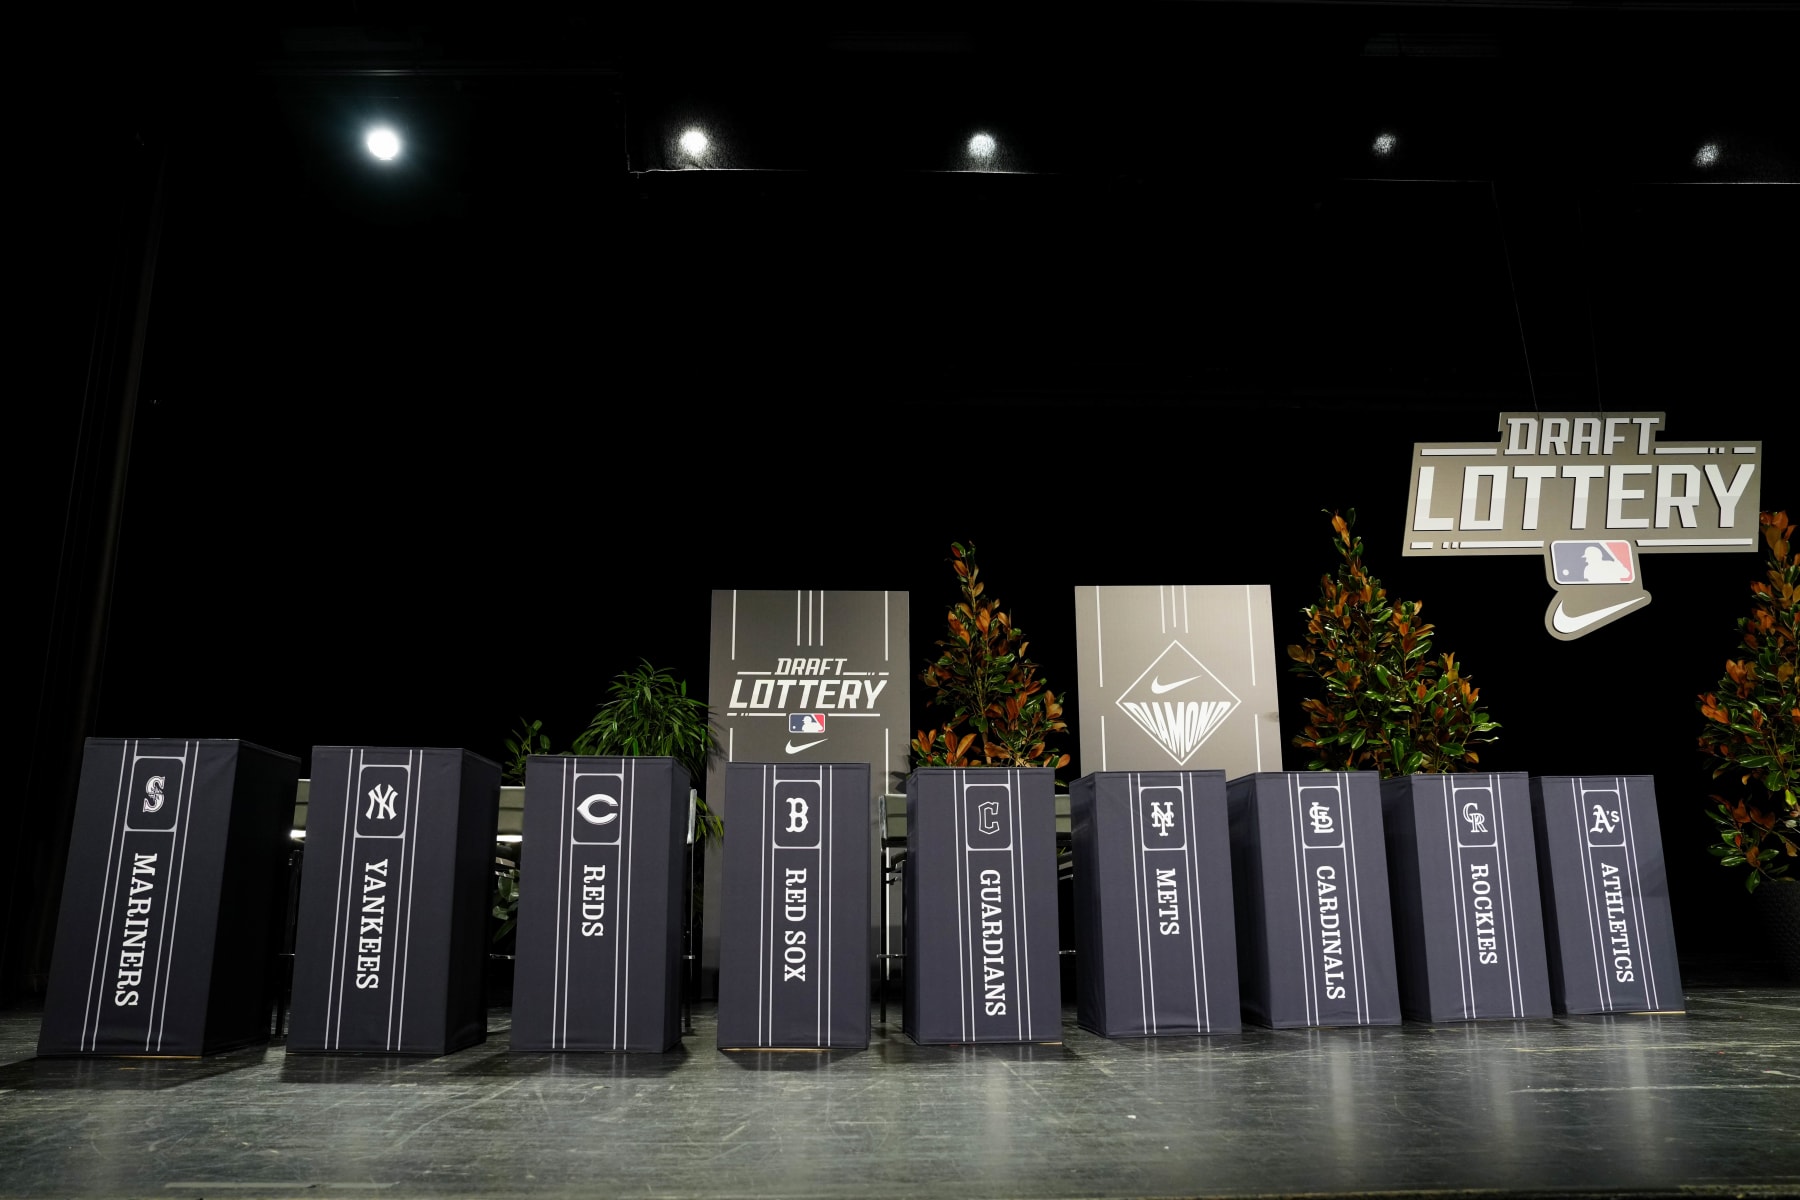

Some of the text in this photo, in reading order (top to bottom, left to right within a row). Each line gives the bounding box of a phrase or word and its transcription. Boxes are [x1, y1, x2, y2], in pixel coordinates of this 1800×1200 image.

[1503, 417, 1660, 455] DRAFT
[1413, 464, 1755, 531] LOTTERY
[729, 679, 887, 710] LOTTERY
[774, 658, 848, 676] DRAFT
[1124, 702, 1231, 758] DIAMOND
[577, 793, 618, 825] C
[785, 797, 809, 833] B
[977, 801, 1000, 835] C
[114, 852, 158, 1008] MARINERS
[355, 858, 388, 989] YANKEES
[582, 865, 606, 937] REDS
[784, 868, 807, 982] RED SOX
[1156, 868, 1179, 936] METS
[1316, 865, 1345, 1000] CARDINALS
[1470, 864, 1497, 964] ROCKIES
[1601, 862, 1634, 983] ATHLETICS
[979, 869, 1006, 1016] GUARDIANS
